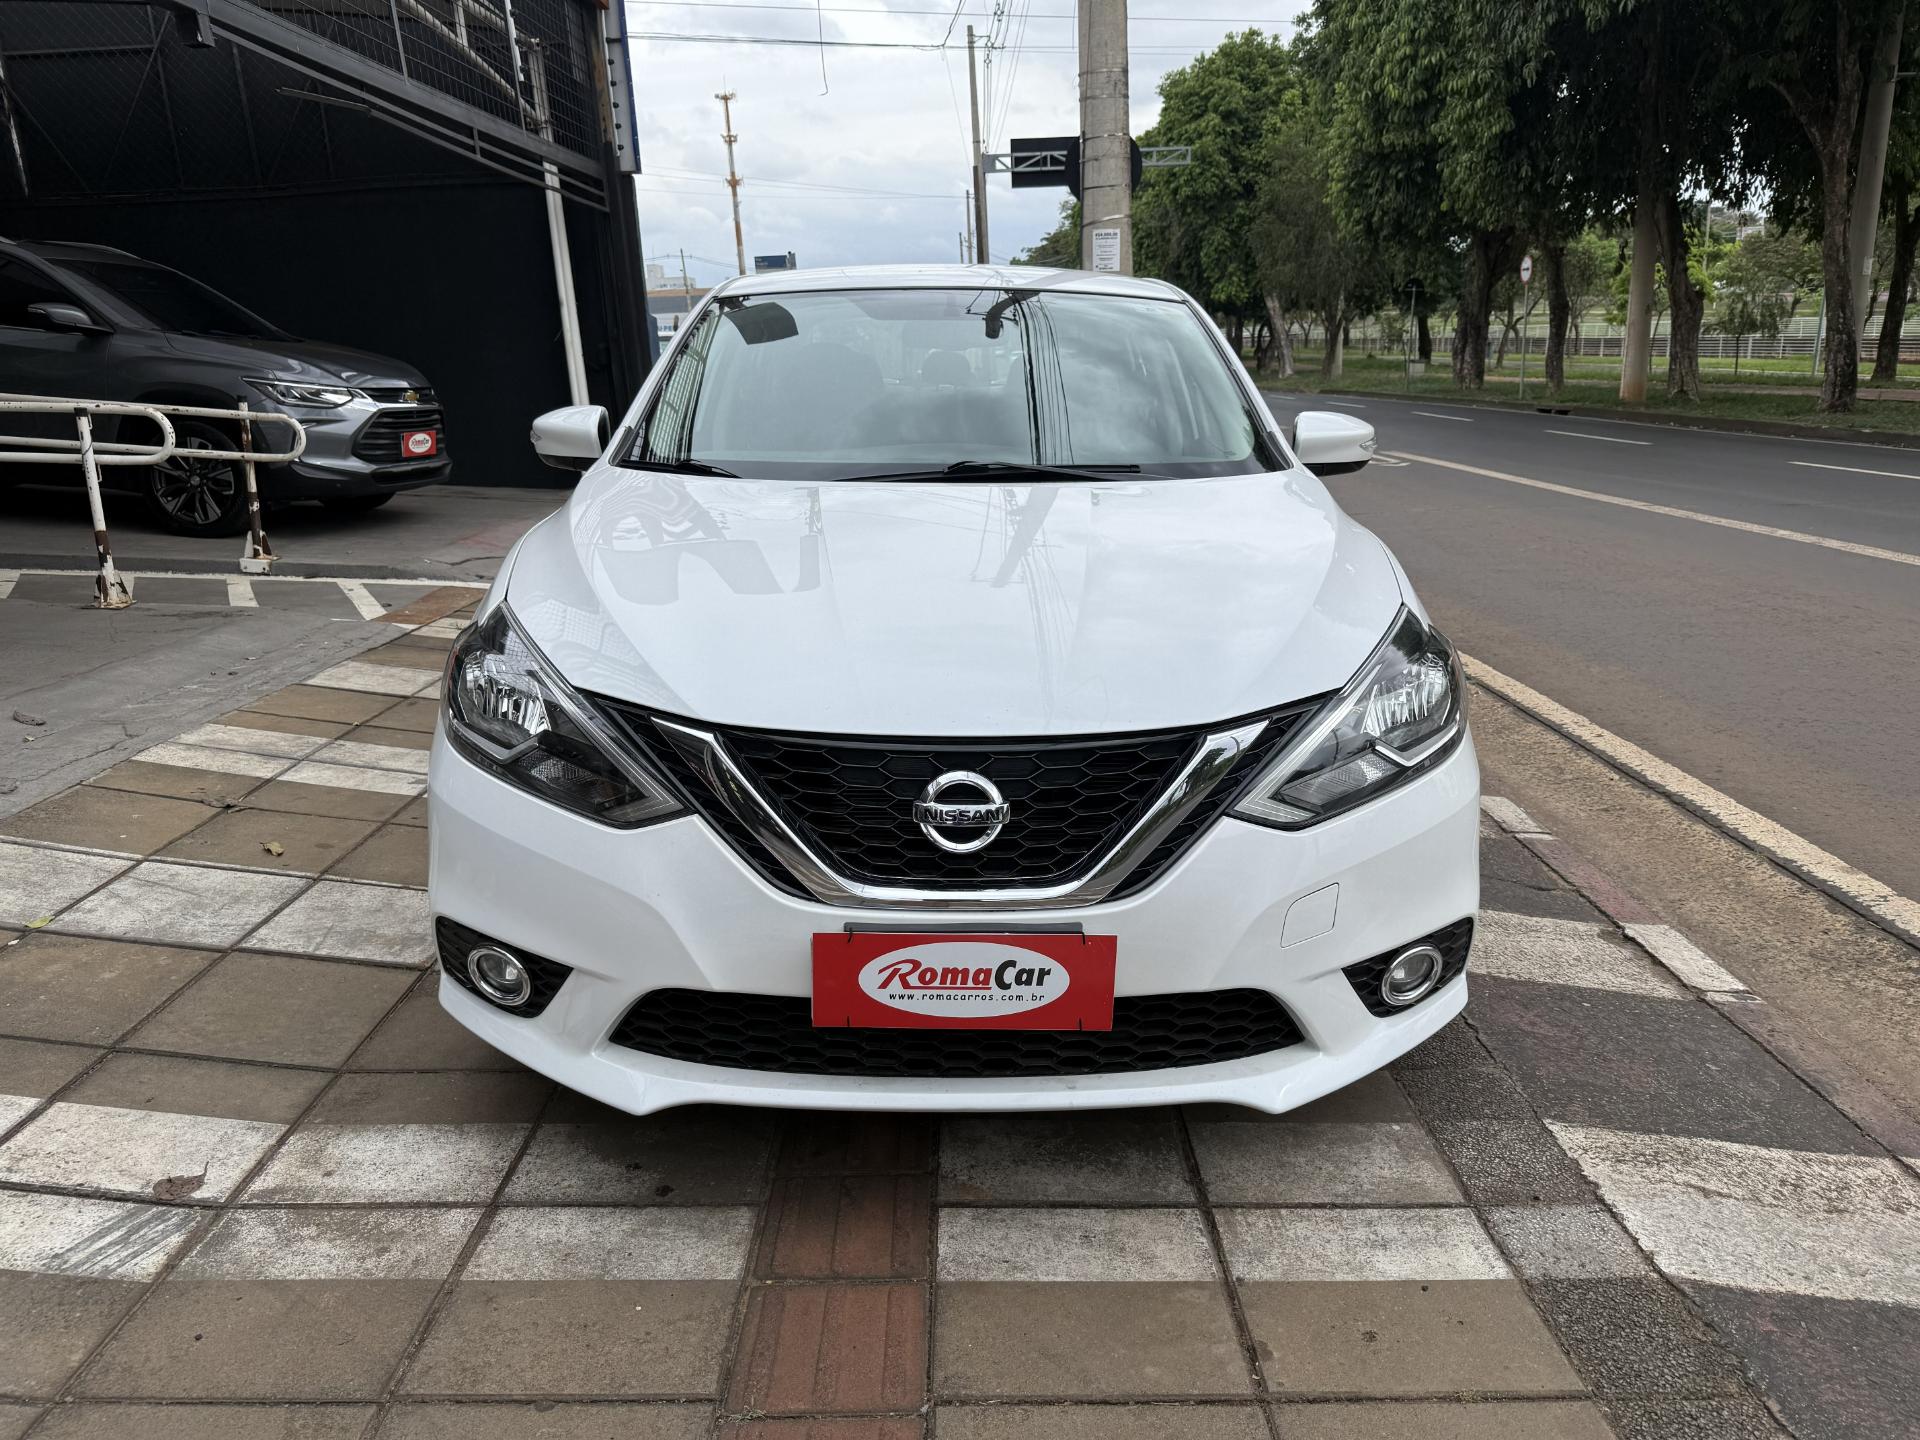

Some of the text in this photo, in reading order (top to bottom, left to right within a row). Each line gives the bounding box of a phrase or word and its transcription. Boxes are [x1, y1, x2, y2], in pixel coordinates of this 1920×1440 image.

[920, 806, 1004, 823] NISSAN
[877, 958, 1052, 991] RomaCar
[888, 992, 1045, 1002] www.romacarros.com.br
